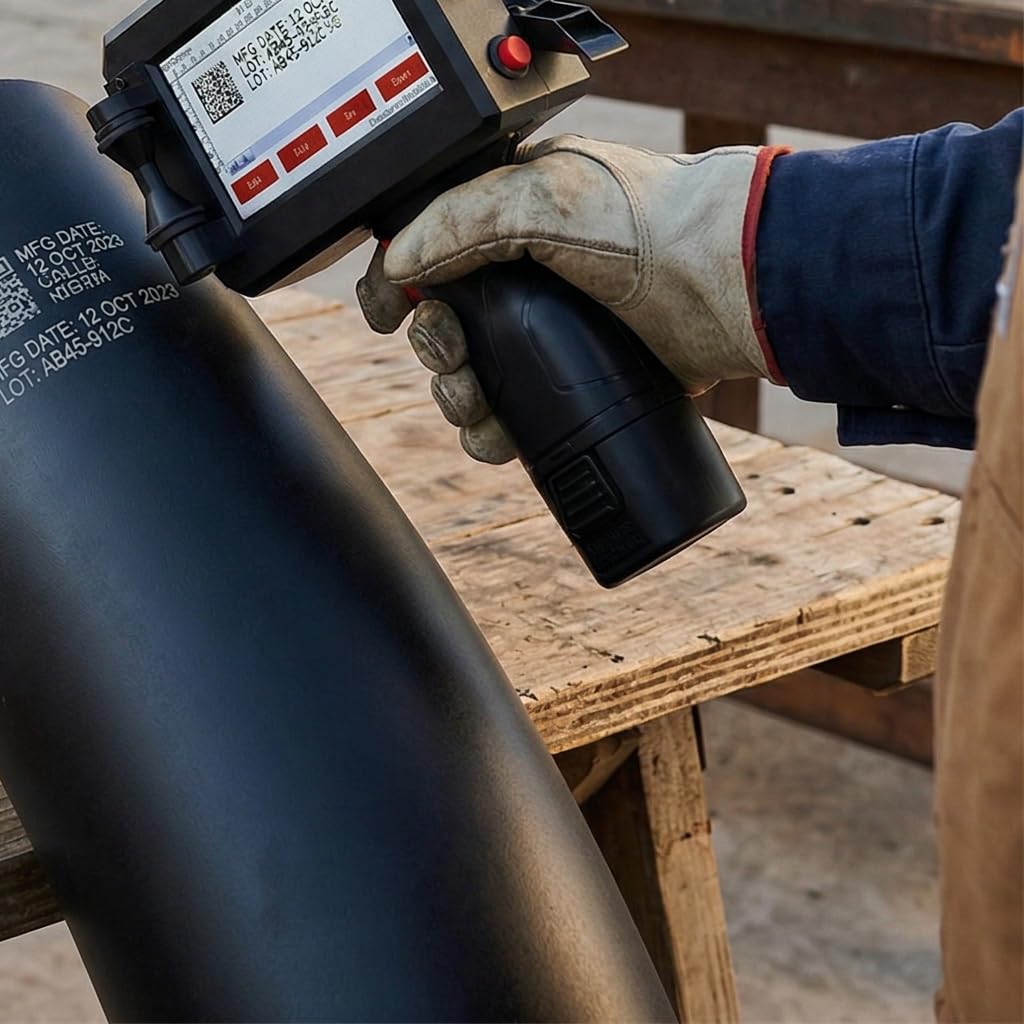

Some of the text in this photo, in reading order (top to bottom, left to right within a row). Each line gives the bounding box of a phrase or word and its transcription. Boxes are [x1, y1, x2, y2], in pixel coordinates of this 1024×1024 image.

[232, 41, 258, 67] MFG
[288, 7, 302, 28] 12
[239, 54, 268, 79] LOT:
[246, 66, 274, 93] LOT:
[14, 221, 106, 263] MFG DATE:
[27, 233, 125, 277] 12 OCT 2023
[24, 320, 79, 359] DATE:
[78, 307, 102, 328] 12
[100, 291, 139, 318] OCT
[138, 283, 180, 307] 2023
[41, 316, 135, 377] AB45-912C
